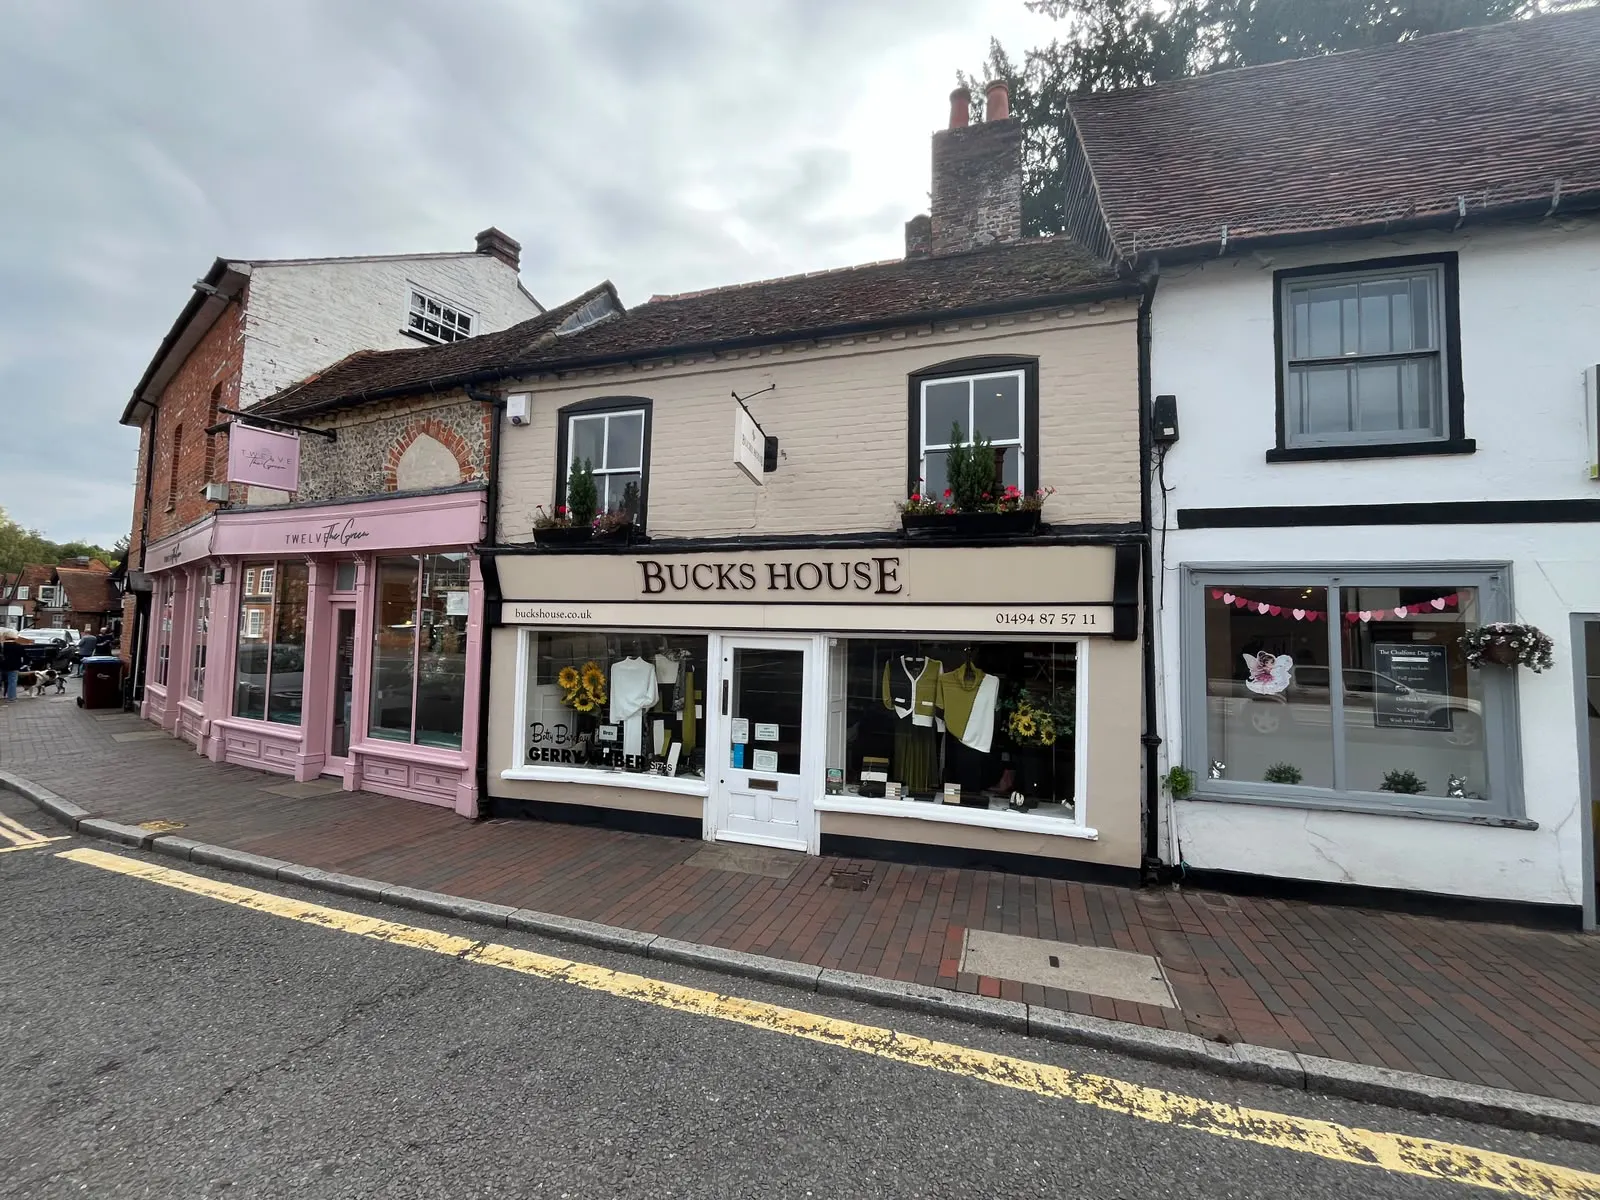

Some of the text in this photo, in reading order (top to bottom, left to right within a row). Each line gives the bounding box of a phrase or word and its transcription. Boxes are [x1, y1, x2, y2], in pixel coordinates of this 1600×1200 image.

[285, 517, 370, 548] TWELVE The Green
[636, 557, 902, 595] BUCKS HOUSE
[515, 608, 592, 619] buckshouse.co.uk
[995, 613, 1097, 625] 01494 87 57 11
[528, 747, 645, 769] GERRY BER
